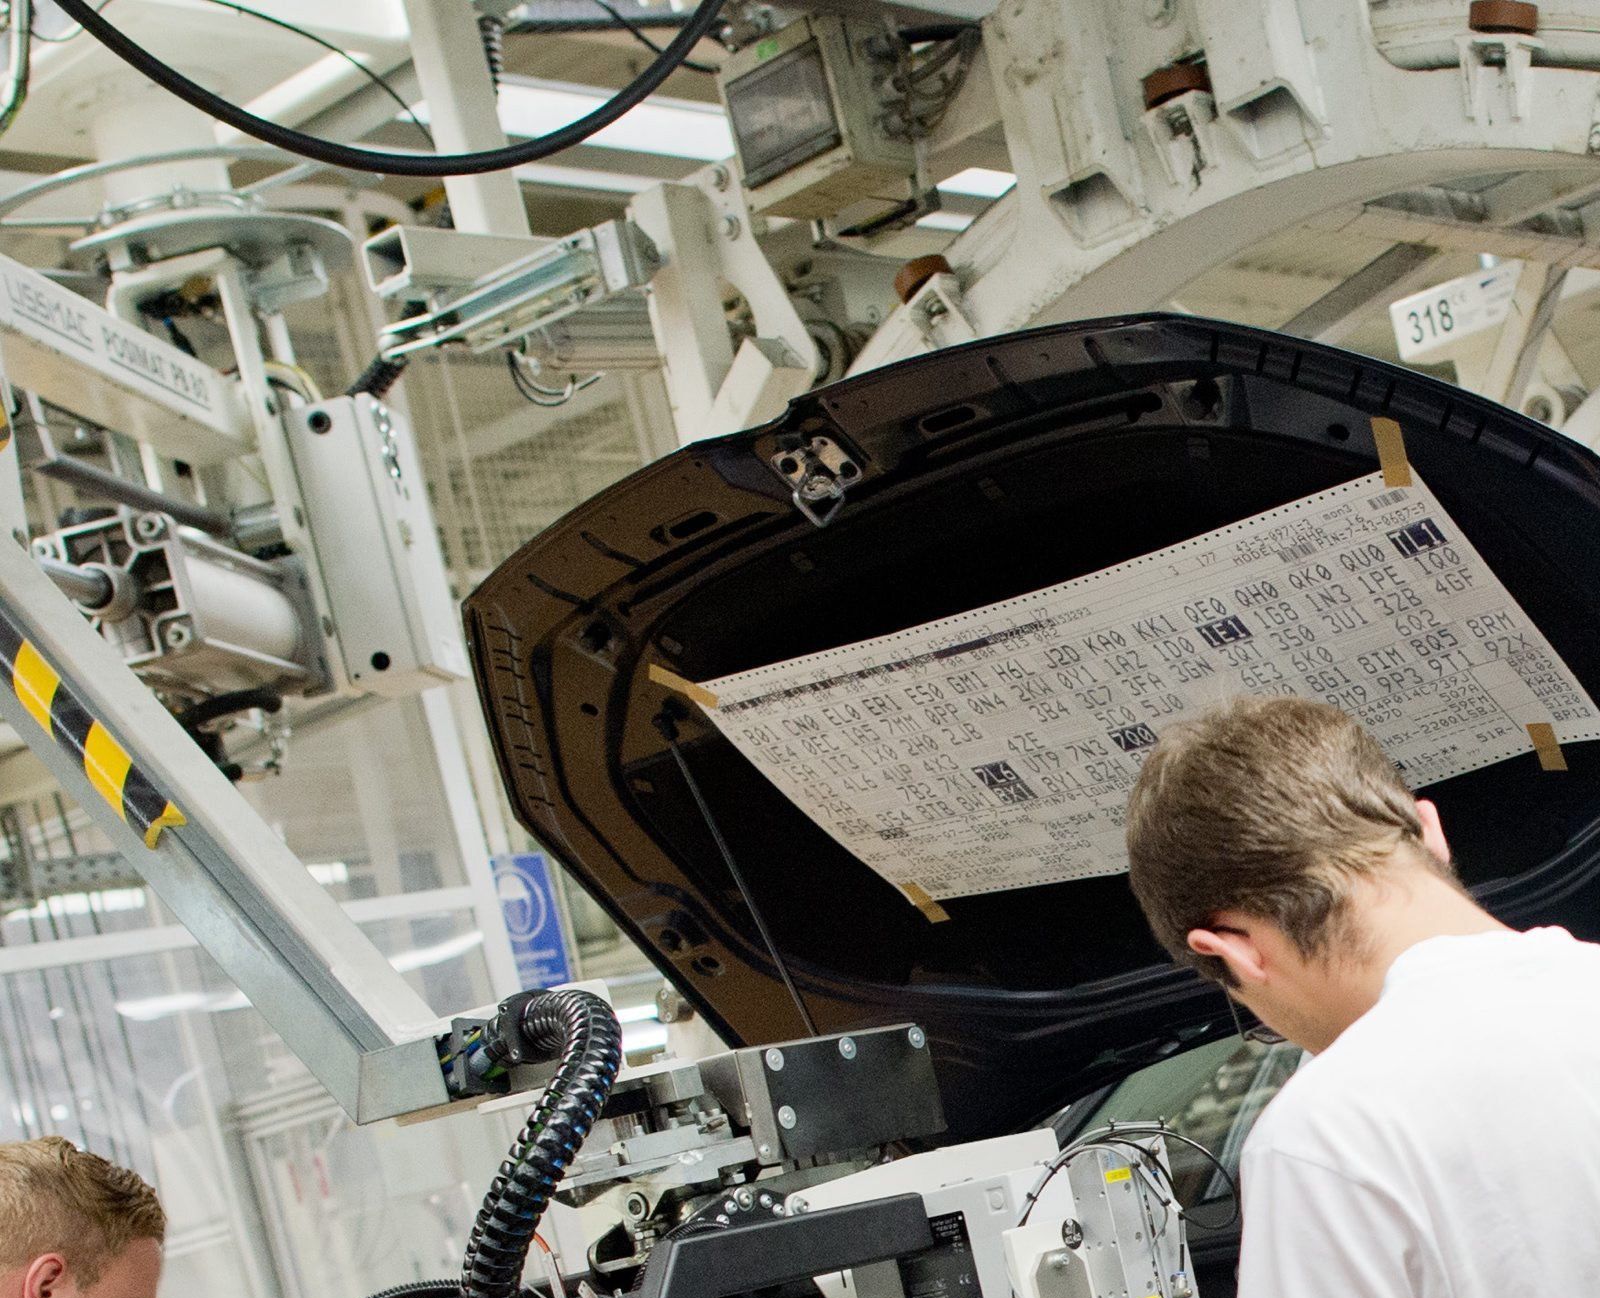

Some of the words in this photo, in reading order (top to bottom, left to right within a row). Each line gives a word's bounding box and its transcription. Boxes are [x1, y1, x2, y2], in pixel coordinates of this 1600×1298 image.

[1407, 298, 1454, 344] 318
[760, 745, 799, 764] UE4
[800, 733, 839, 755] 0EC
[878, 714, 922, 734] 7MM
[924, 702, 959, 725] 0PP
[966, 692, 1007, 714] 0N4
[1009, 676, 1055, 702] 2KW
[1056, 665, 1098, 689] 0Y1
[1152, 636, 1194, 662] 1D0
[1198, 617, 1249, 646] 1E1
[1253, 601, 1299, 629] 1G8
[1304, 583, 1351, 612] 1N3
[1357, 565, 1405, 594] 1PE
[1409, 546, 1460, 575] 1Q0
[781, 714, 820, 736] CN0
[821, 703, 861, 726] EL0
[861, 693, 902, 716] ER1
[946, 670, 988, 694] GM1
[990, 659, 1035, 682] H6L
[1043, 644, 1080, 669] J2D
[1082, 630, 1126, 655] KA0
[1131, 614, 1178, 641] KK1
[1183, 597, 1226, 623] QE0
[1234, 580, 1278, 607] QH0
[1288, 563, 1332, 589] QK0
[1385, 521, 1444, 556] TL1
[1195, 551, 1215, 567] 177
[817, 800, 857, 818] 7AA
[895, 782, 937, 801] 7B2
[935, 772, 977, 793] 7K1
[972, 762, 1019, 787] 7L6
[1064, 739, 1108, 761] 7N3
[1109, 725, 1158, 750] 7Q0
[1304, 666, 1351, 692] 8G1
[1356, 647, 1405, 674] 8IM
[1409, 628, 1458, 656] 8Q5
[1465, 611, 1515, 638] 8RM
[820, 753, 859, 775] 1T3
[860, 743, 898, 765] 1X0
[899, 733, 939, 756] 2H0
[941, 722, 983, 745] 2JB
[1028, 700, 1070, 723] 3B4
[1074, 684, 1112, 709] 3C7
[1121, 672, 1166, 696] 3FA
[1168, 656, 1215, 683] 3GN
[1218, 639, 1262, 667] 3QT
[1321, 606, 1368, 634] 3U1
[1435, 567, 1472, 595] 4GF
[842, 773, 878, 792] 4L6
[882, 763, 913, 783] 4UP
[922, 753, 959, 773] 4X3
[1007, 731, 1045, 753] 4ZE
[1093, 705, 1136, 730] 5C0
[1139, 693, 1184, 718] 5J0
[1240, 661, 1283, 688] 6E3
[1291, 645, 1337, 672] 6K0
[1394, 608, 1444, 636] 6Q2
[990, 781, 1036, 805] 8X1
[1040, 770, 1085, 794] 8Y1
[1084, 758, 1129, 783] 8ZH
[1325, 684, 1375, 713] 9M9
[1376, 667, 1423, 693] 9P3
[1427, 649, 1478, 677] 9T1
[1483, 632, 1533, 658] 9ZX
